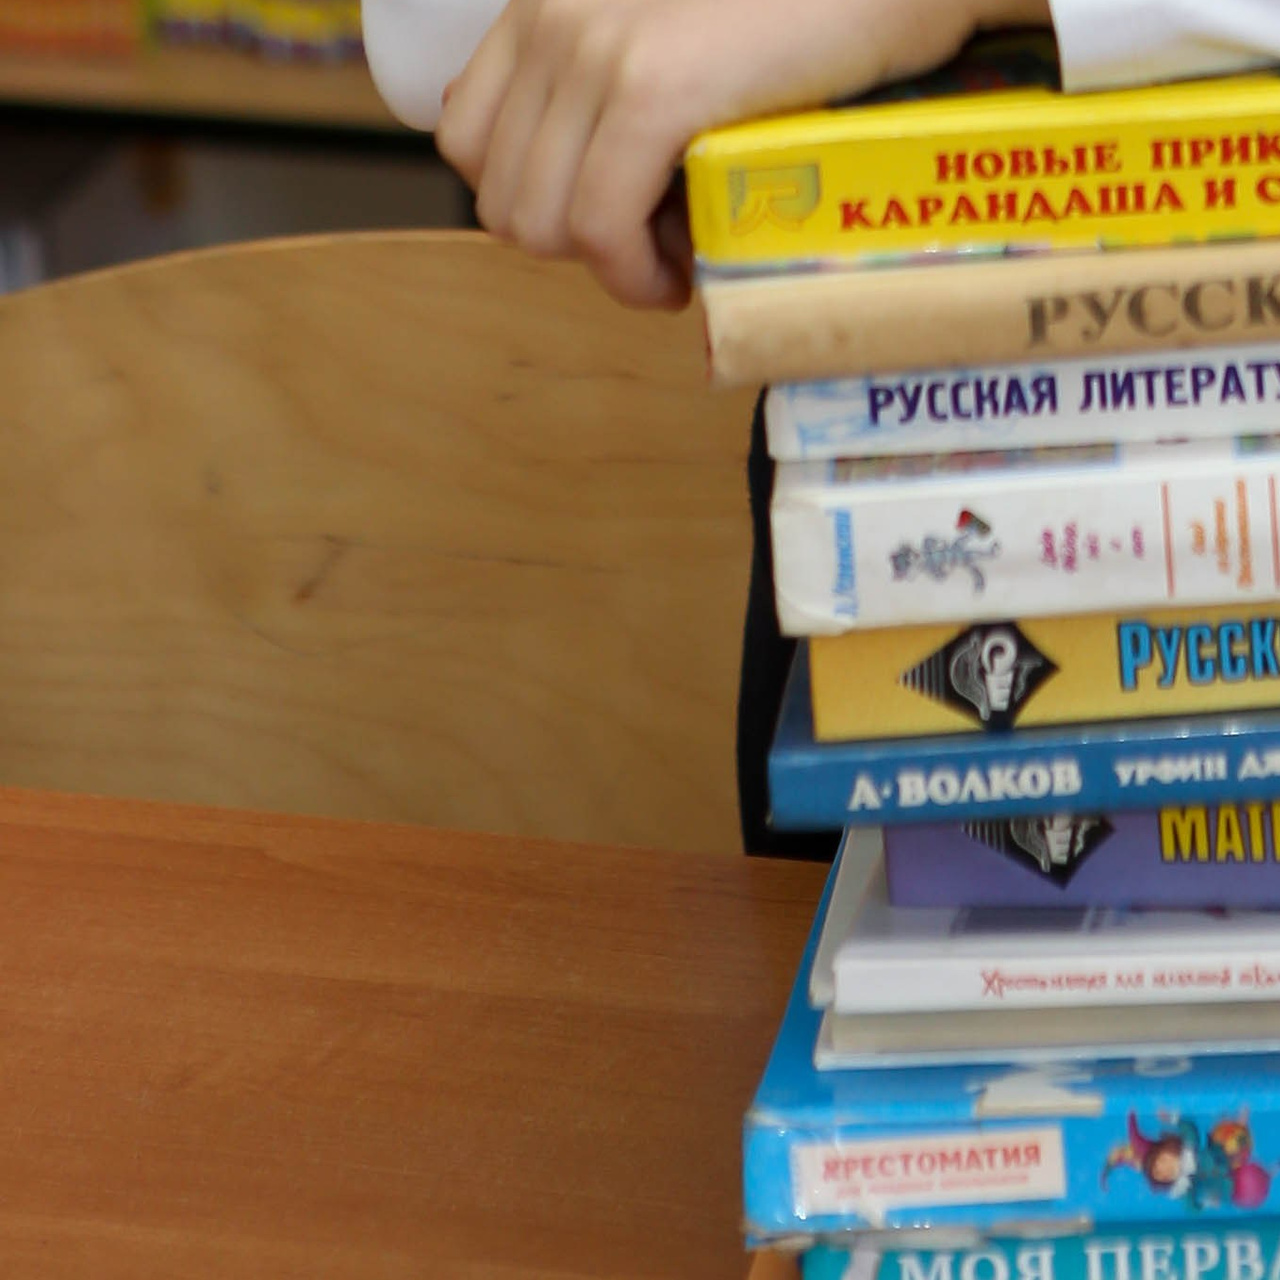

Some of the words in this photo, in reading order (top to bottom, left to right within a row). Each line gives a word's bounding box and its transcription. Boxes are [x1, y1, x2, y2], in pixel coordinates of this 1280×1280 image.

[936, 142, 1121, 185] НОВЫЕ
[840, 181, 1184, 232] КАРАНДАША
[1205, 177, 1237, 209] И
[868, 374, 1059, 426] РУССКАЯ
[1113, 754, 1228, 788] УРФИН
